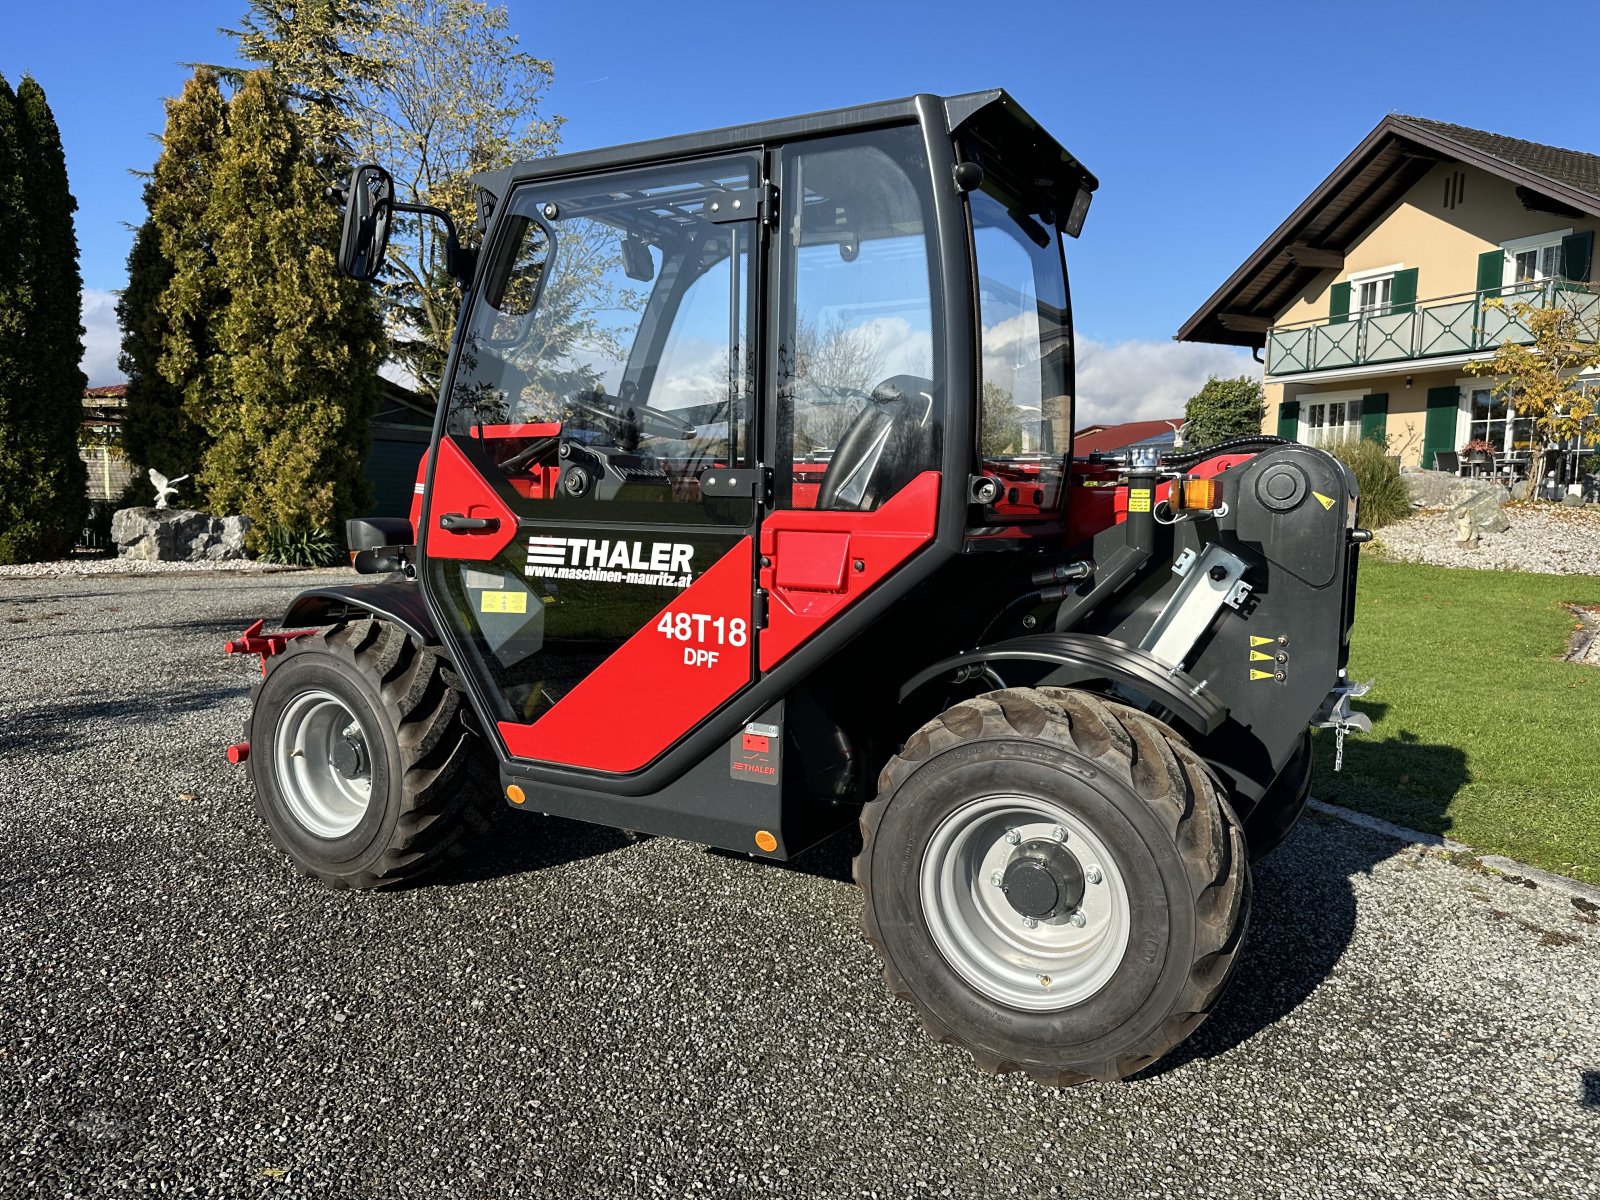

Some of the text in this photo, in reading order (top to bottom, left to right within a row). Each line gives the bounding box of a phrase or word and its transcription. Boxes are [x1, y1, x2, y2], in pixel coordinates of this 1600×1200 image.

[567, 538, 694, 573] THALER
[525, 566, 693, 588] www.maschinen-mauritz.at
[657, 612, 747, 647] 48T18
[683, 648, 719, 669] DPF
[743, 764, 776, 775] THALER
